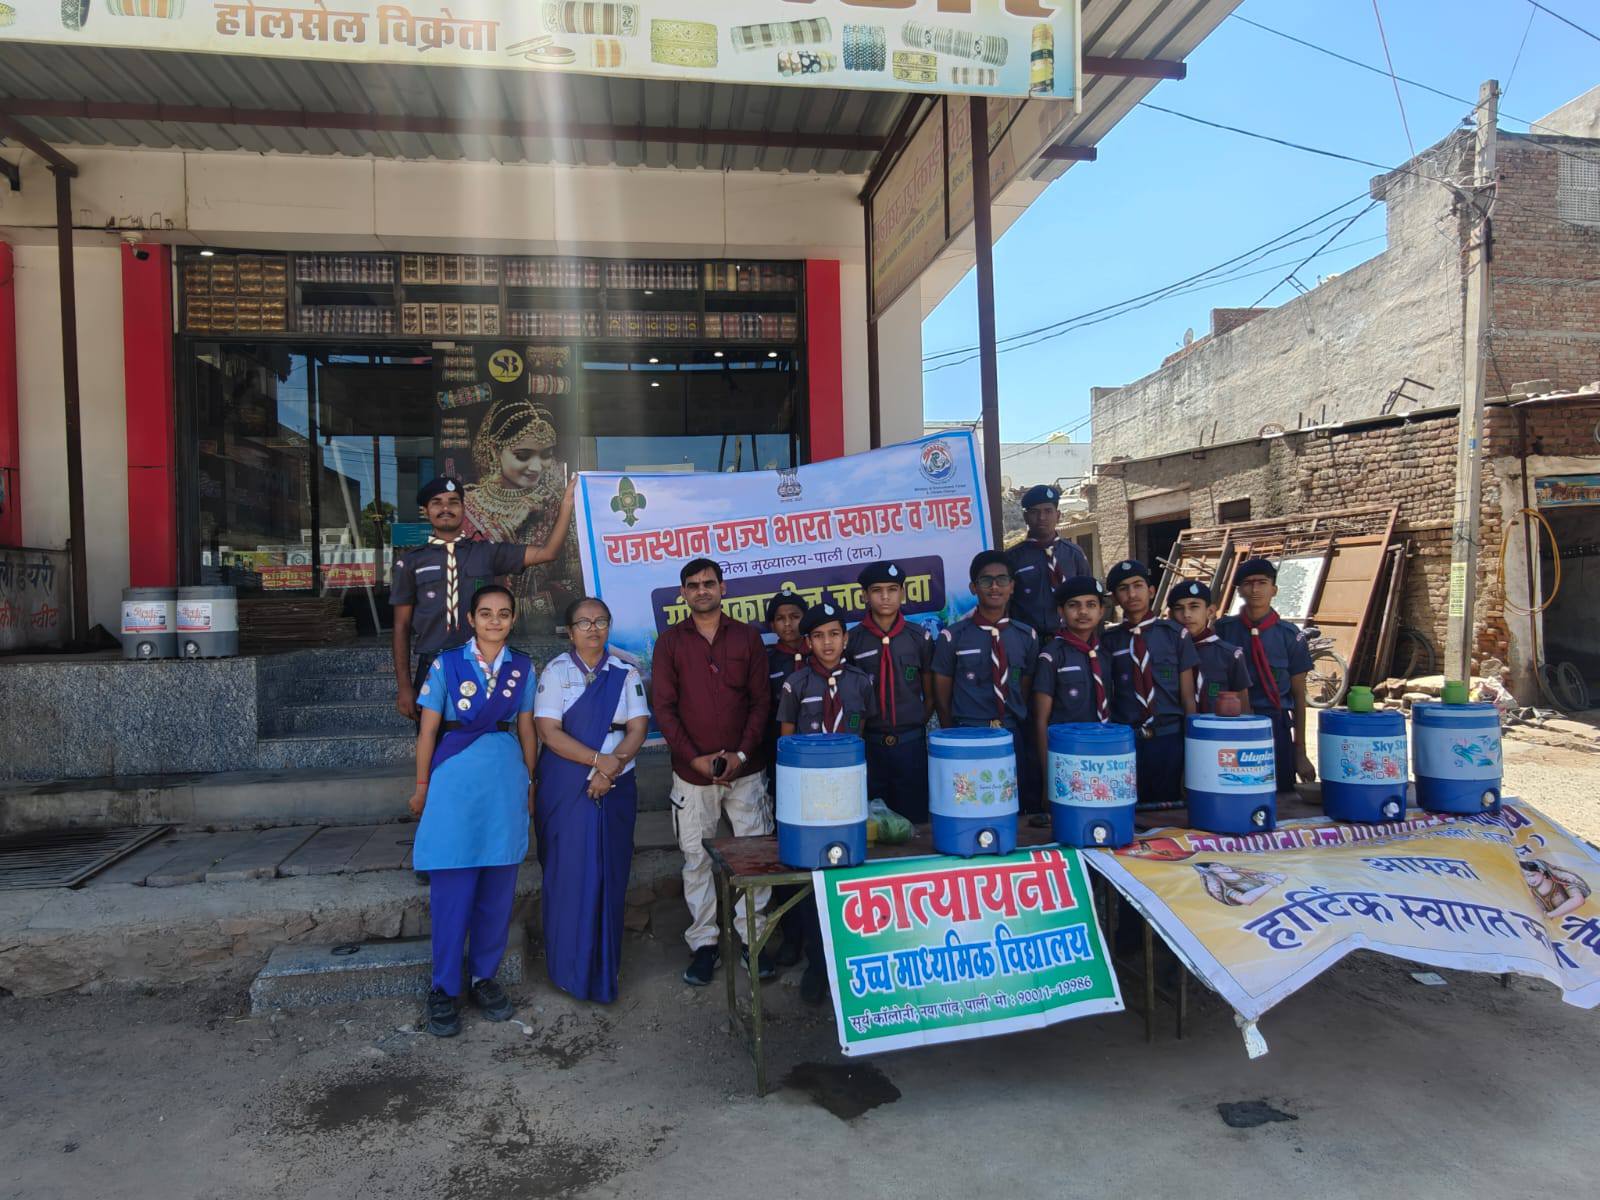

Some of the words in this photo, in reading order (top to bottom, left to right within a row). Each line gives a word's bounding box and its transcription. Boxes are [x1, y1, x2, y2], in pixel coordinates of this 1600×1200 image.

[213, 0, 368, 44] होलसेल
[377, 5, 501, 53] विक्रेता
[603, 525, 710, 564] राजस्थान
[713, 518, 768, 552] राज्य
[773, 509, 832, 544] भारत
[834, 502, 904, 537] स्काउट
[905, 501, 922, 530] व
[924, 496, 973, 530] गाइड
[751, 548, 843, 574] मुख्यालय-पाली
[846, 544, 883, 562] (राज.)
[1080, 759, 1105, 774] Sky
[1106, 759, 1129, 771] Star
[1372, 740, 1394, 754] Sky
[838, 850, 1077, 935] कात्यायनी
[1360, 857, 1481, 881] आपका
[1386, 893, 1521, 939] स्वागत
[848, 956, 892, 996] उच्च
[896, 930, 996, 988] माध्यमिक
[995, 923, 1093, 975] विद्यालय
[849, 1009, 871, 1033] सूर्य
[919, 1005, 938, 1017] नया
[964, 993, 989, 1010] पाली
[1017, 975, 1094, 1005] 90011-19986
